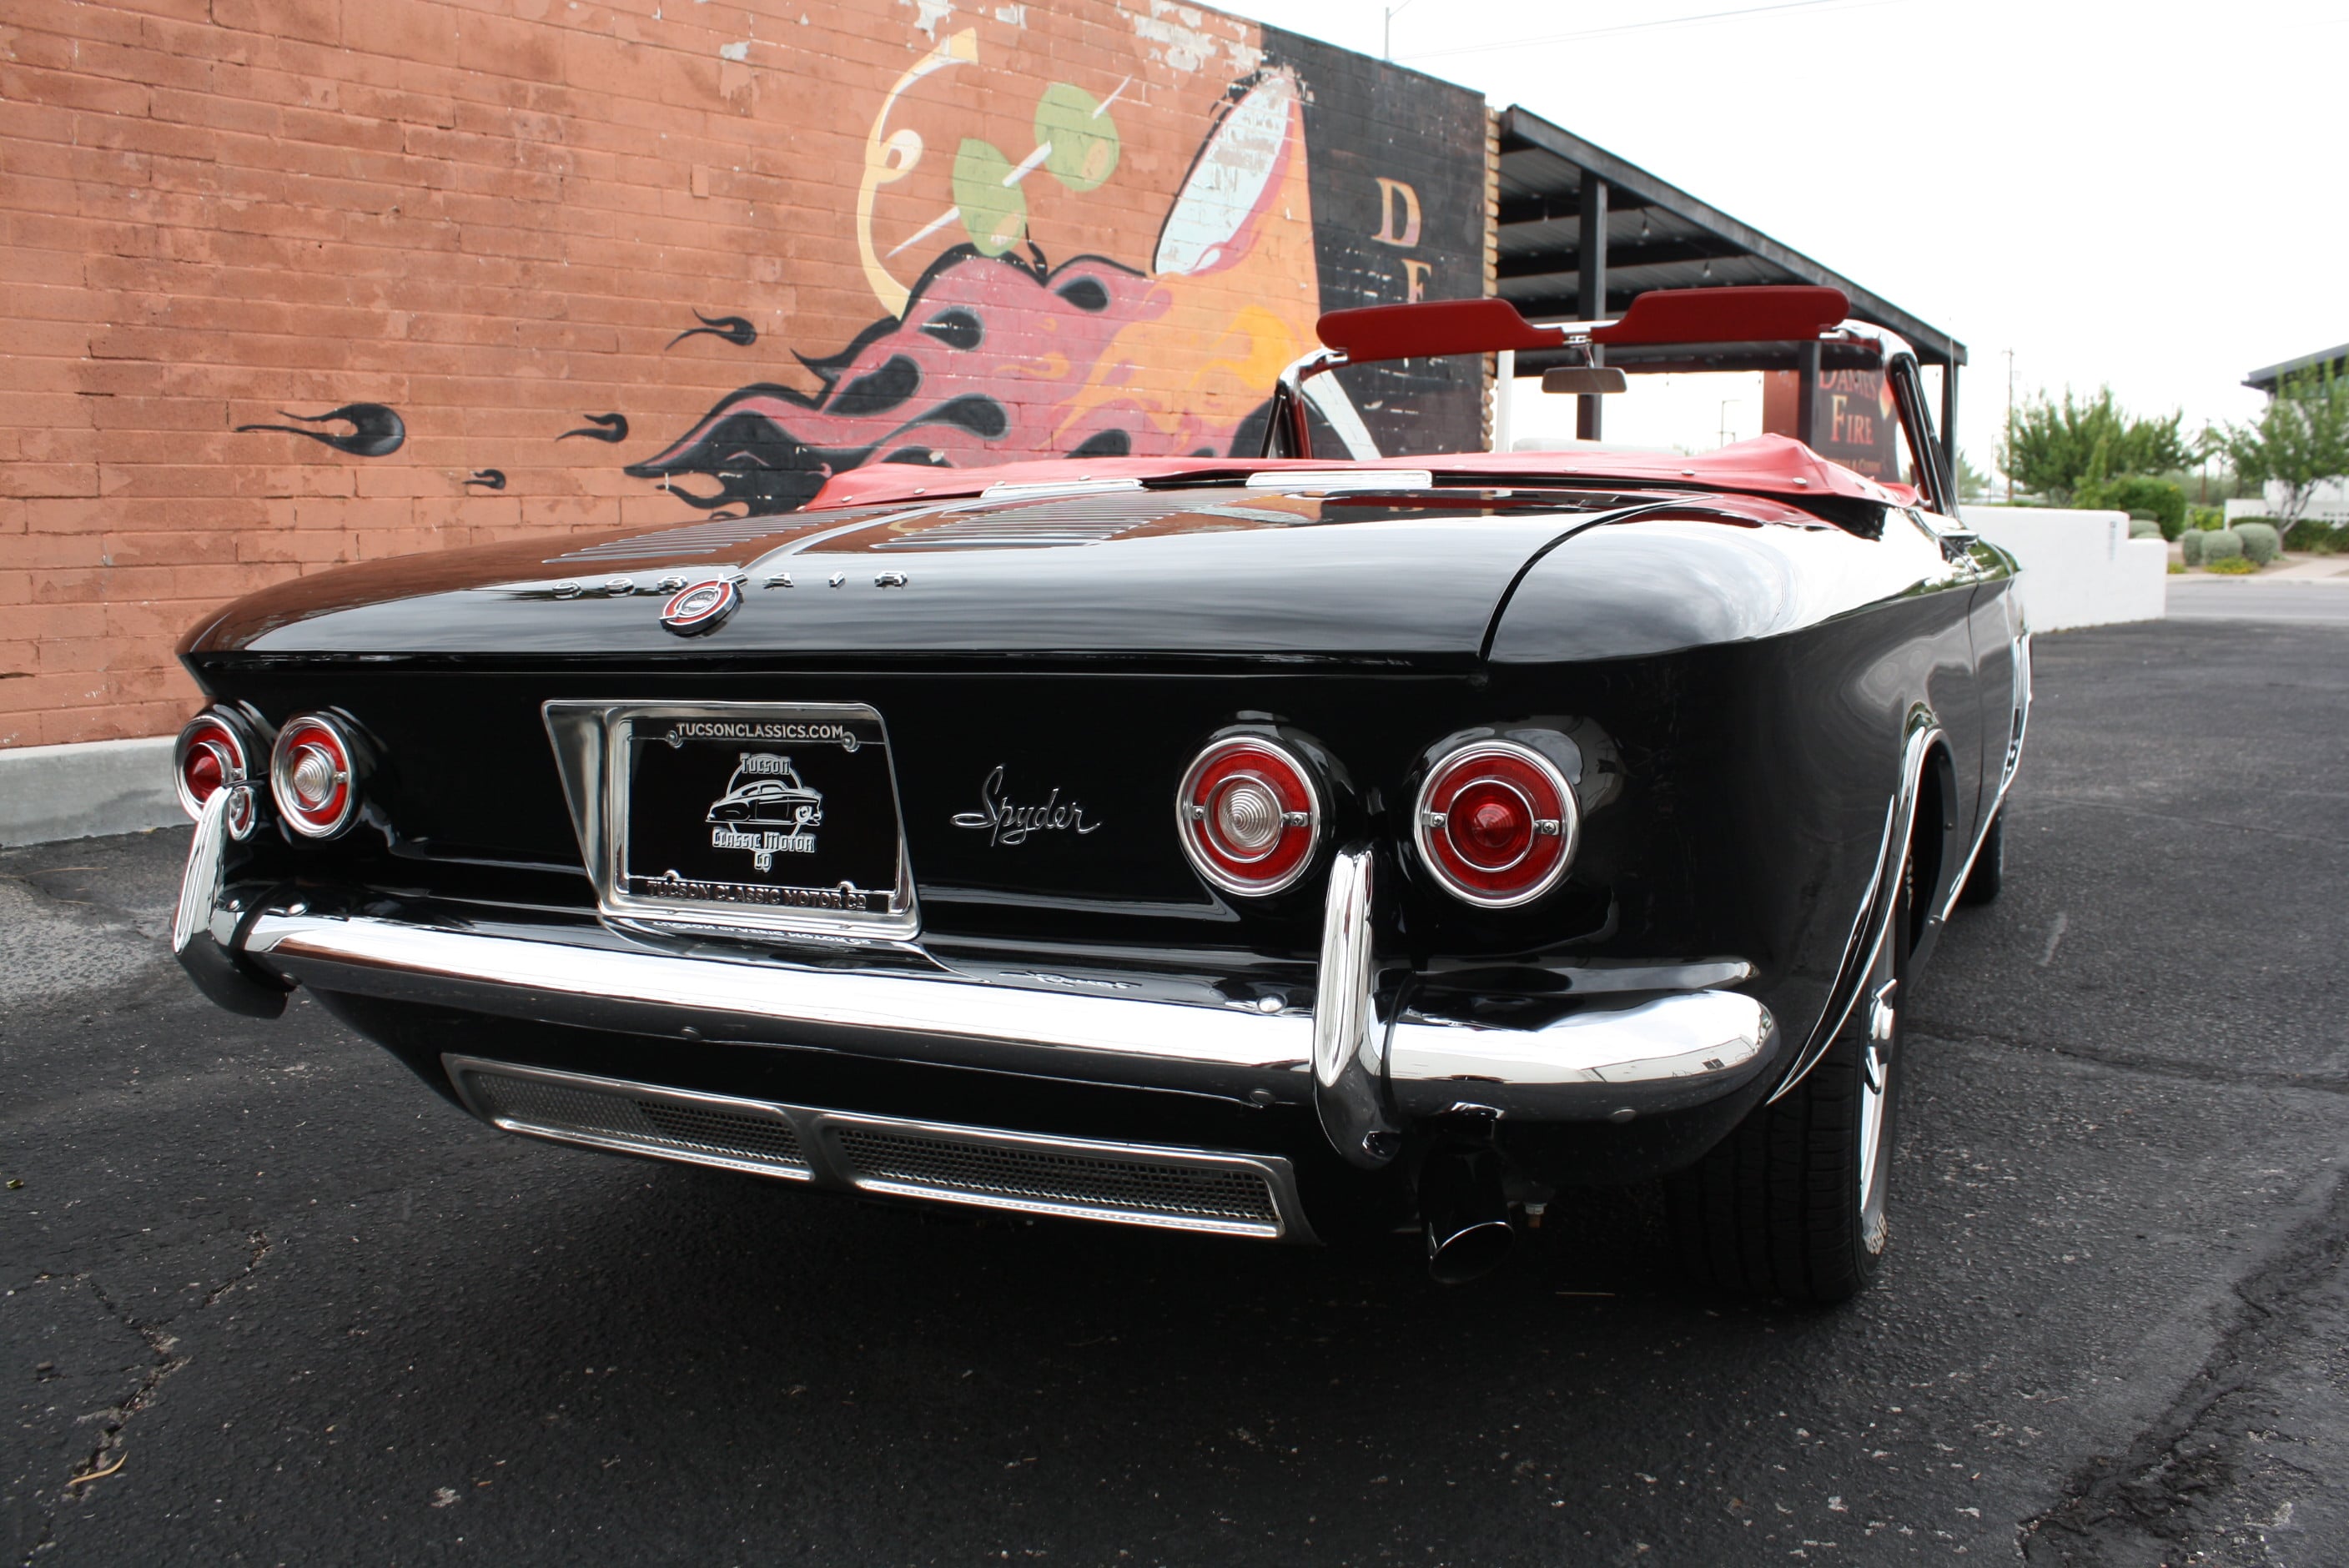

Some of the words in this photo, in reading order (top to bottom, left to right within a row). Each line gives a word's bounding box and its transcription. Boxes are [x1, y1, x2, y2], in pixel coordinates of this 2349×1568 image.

[1371, 177, 1421, 248] D
[1829, 394, 1874, 445] FIRE
[676, 721, 843, 739] TUCSONCLASSICS.COM
[741, 754, 792, 776] TUCSON
[949, 763, 1101, 847] Spyder
[712, 827, 762, 849] CLASSIC
[763, 831, 816, 853] MOTOR
[754, 852, 772, 872] CO
[646, 880, 710, 900] TUCSON
[714, 885, 781, 905] CLASSIC
[783, 889, 843, 909] MOTOR
